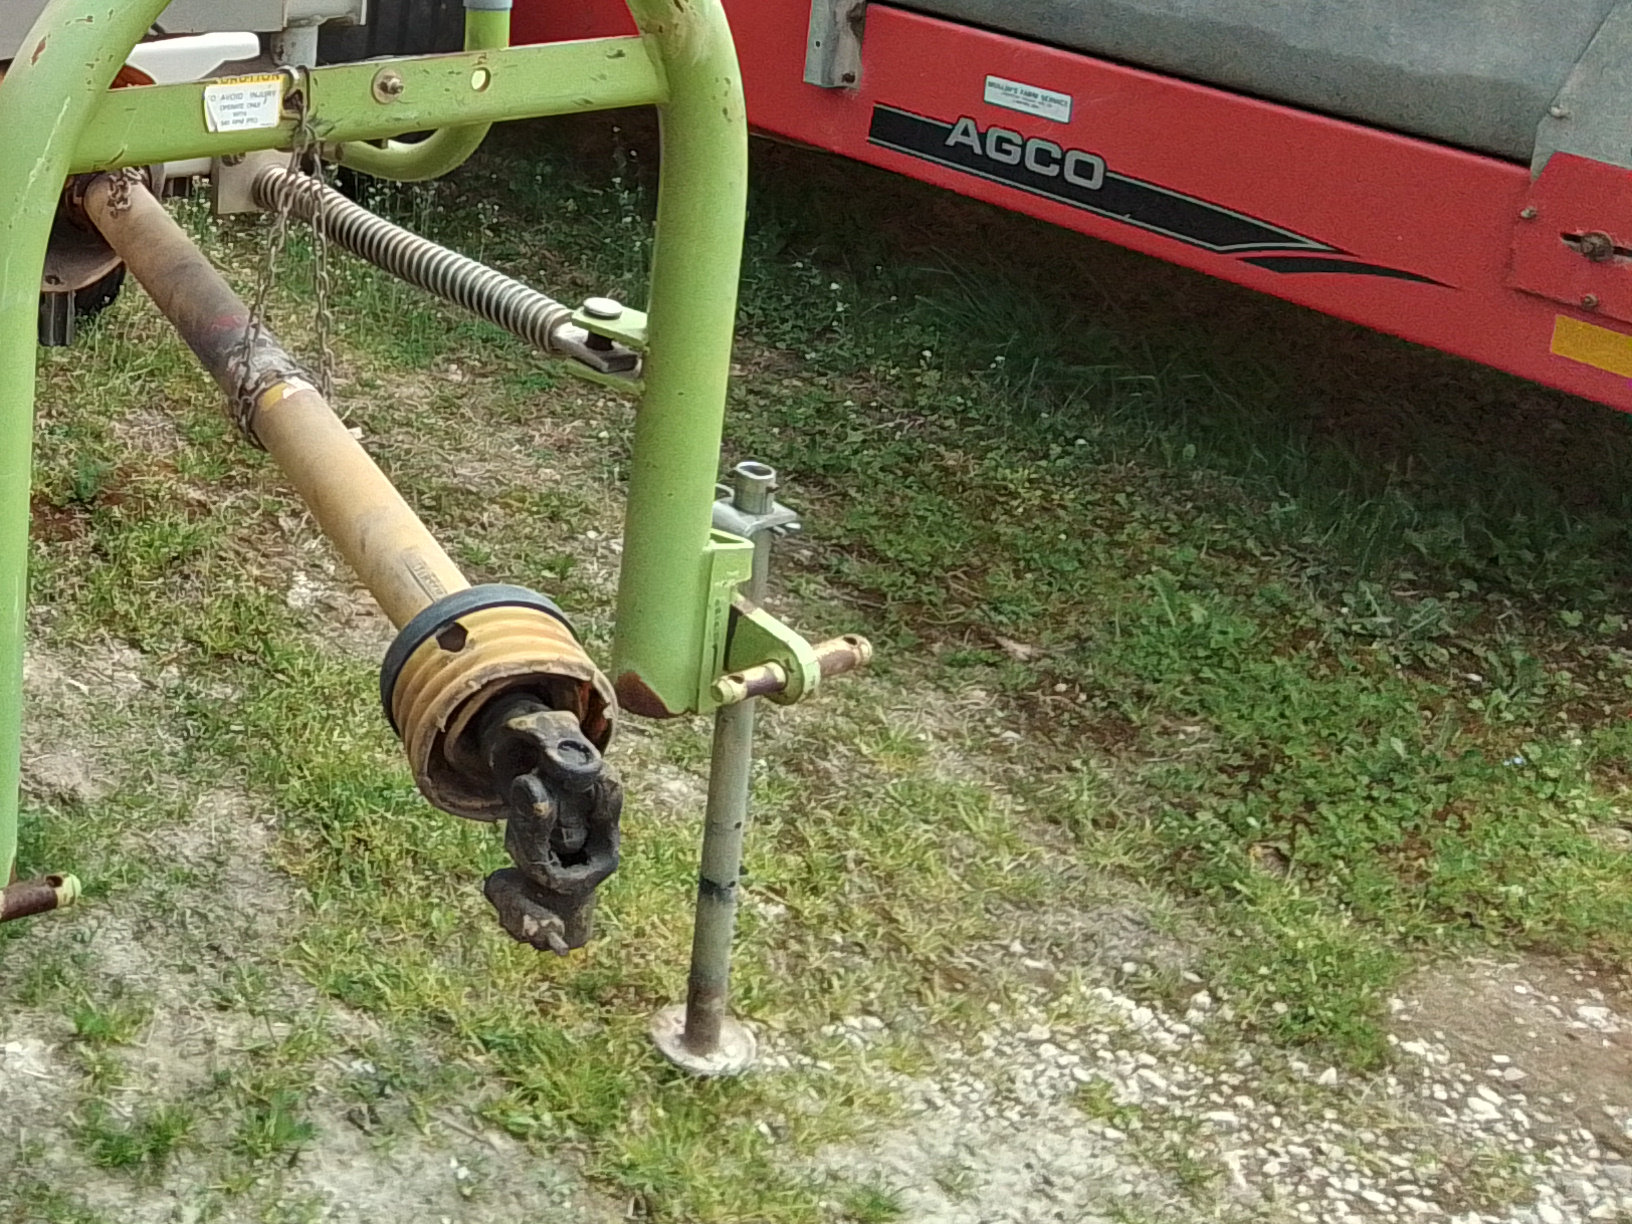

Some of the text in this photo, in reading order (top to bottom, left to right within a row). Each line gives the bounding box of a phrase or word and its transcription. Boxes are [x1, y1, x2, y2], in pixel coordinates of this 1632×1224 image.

[220, 92, 244, 101] AVOID
[249, 90, 277, 99] INJURY
[219, 103, 245, 111] OPERATE
[944, 117, 1106, 191] AGCO
